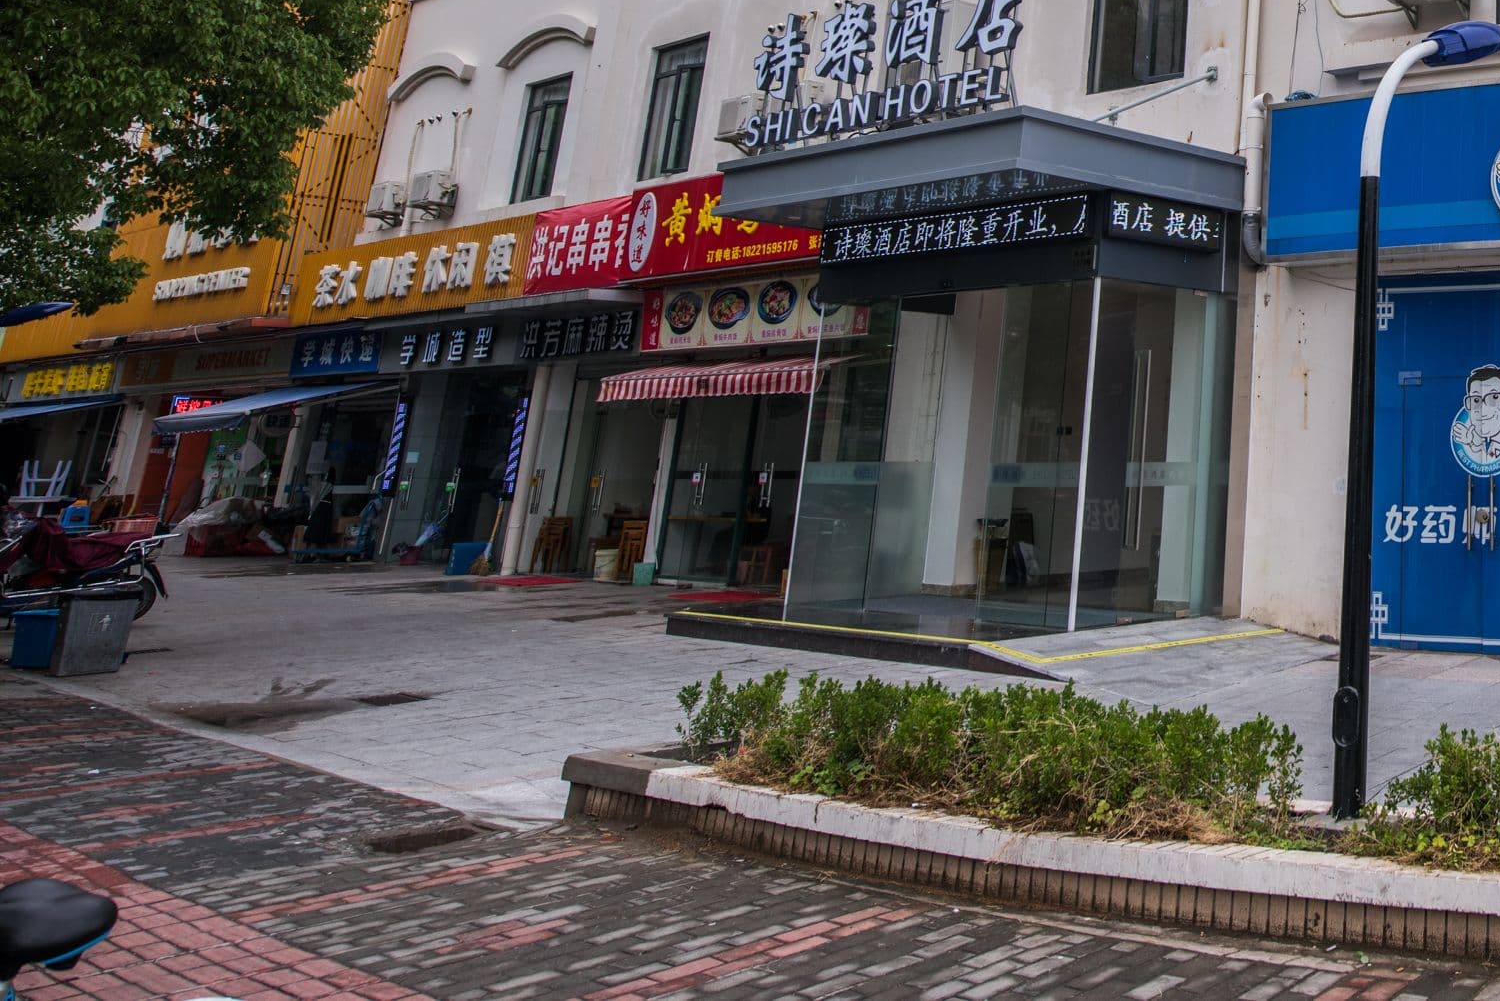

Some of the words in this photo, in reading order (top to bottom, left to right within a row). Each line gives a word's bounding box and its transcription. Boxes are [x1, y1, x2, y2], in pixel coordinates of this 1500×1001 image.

[745, 108, 798, 147] SHI
[801, 91, 877, 137] CAN
[883, 66, 1007, 121] HOTEL
[630, 199, 653, 265] 好味道
[833, 203, 1088, 260] 诗璨酒店即将隆重开业，
[1163, 208, 1219, 242] 提供
[196, 348, 272, 371] SUPERMARKET
